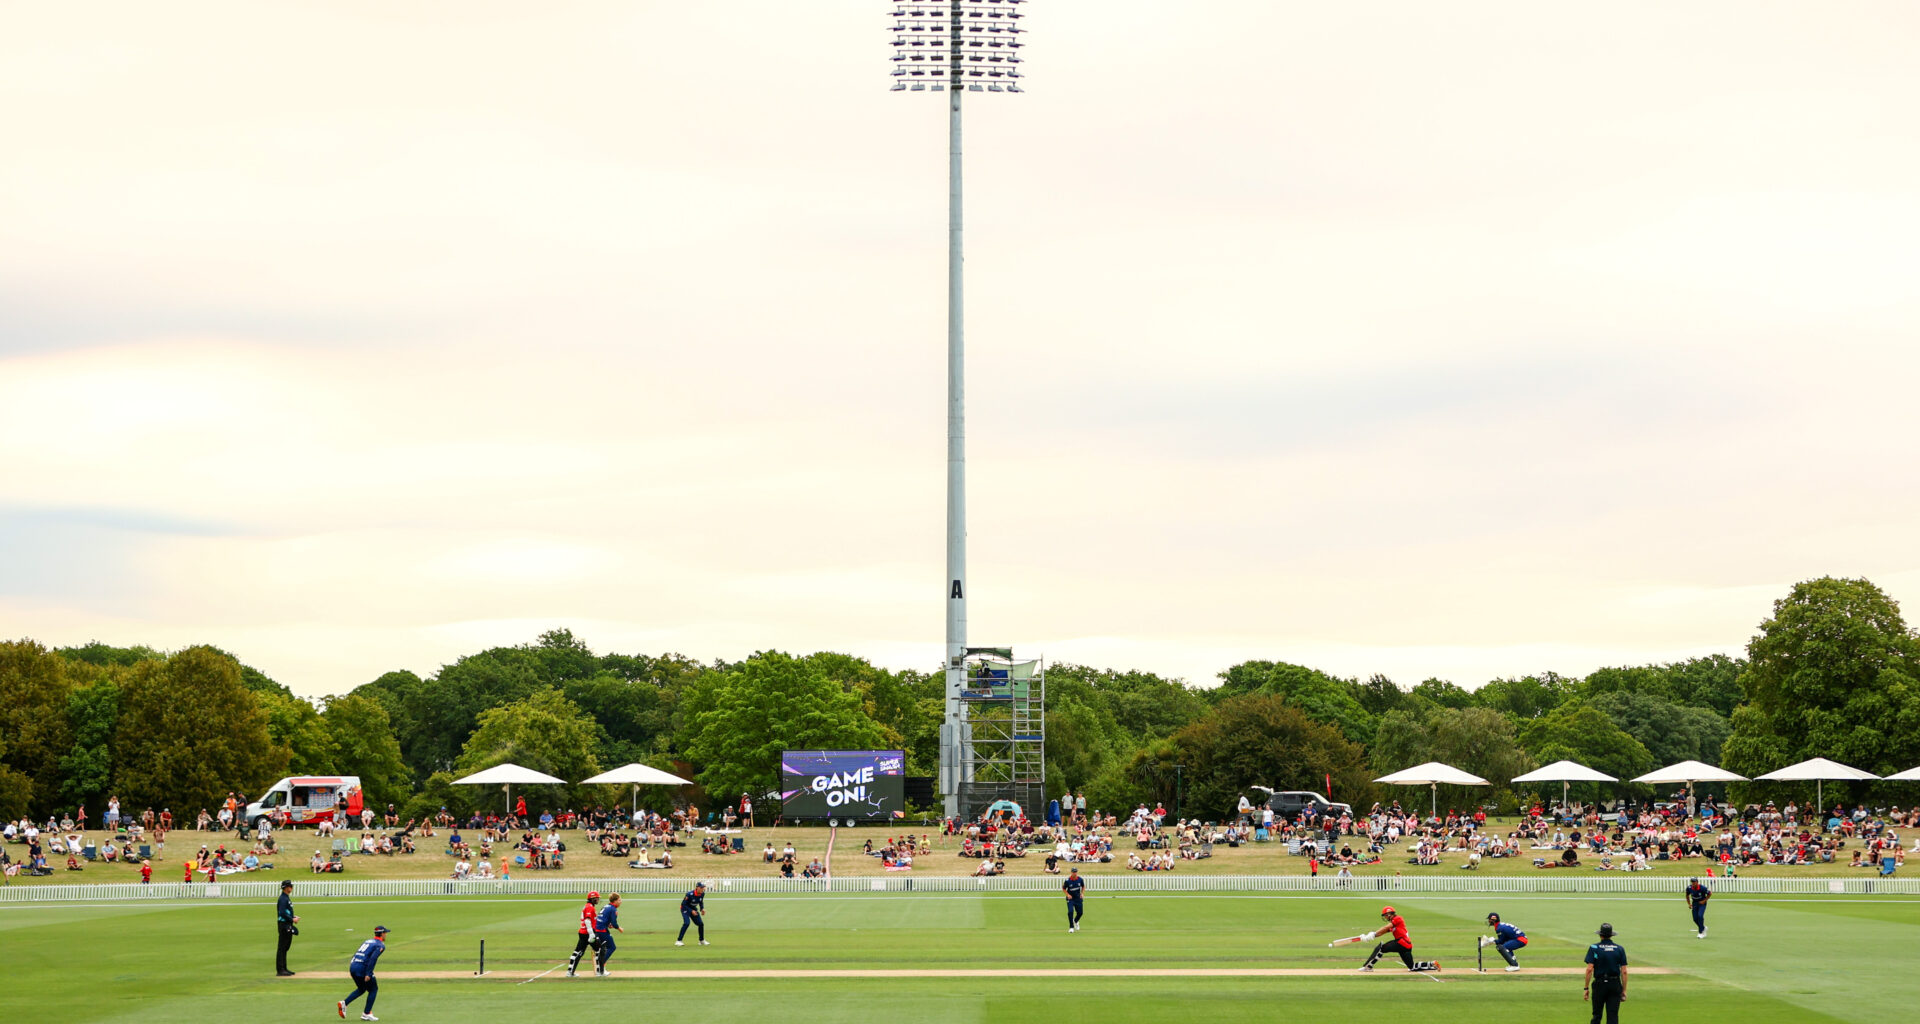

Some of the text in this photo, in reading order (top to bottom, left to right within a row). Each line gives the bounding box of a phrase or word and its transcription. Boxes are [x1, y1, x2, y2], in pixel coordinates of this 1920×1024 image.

[951, 580, 963, 599] A
[812, 766, 874, 792] GAME
[826, 785, 866, 807] ON!
